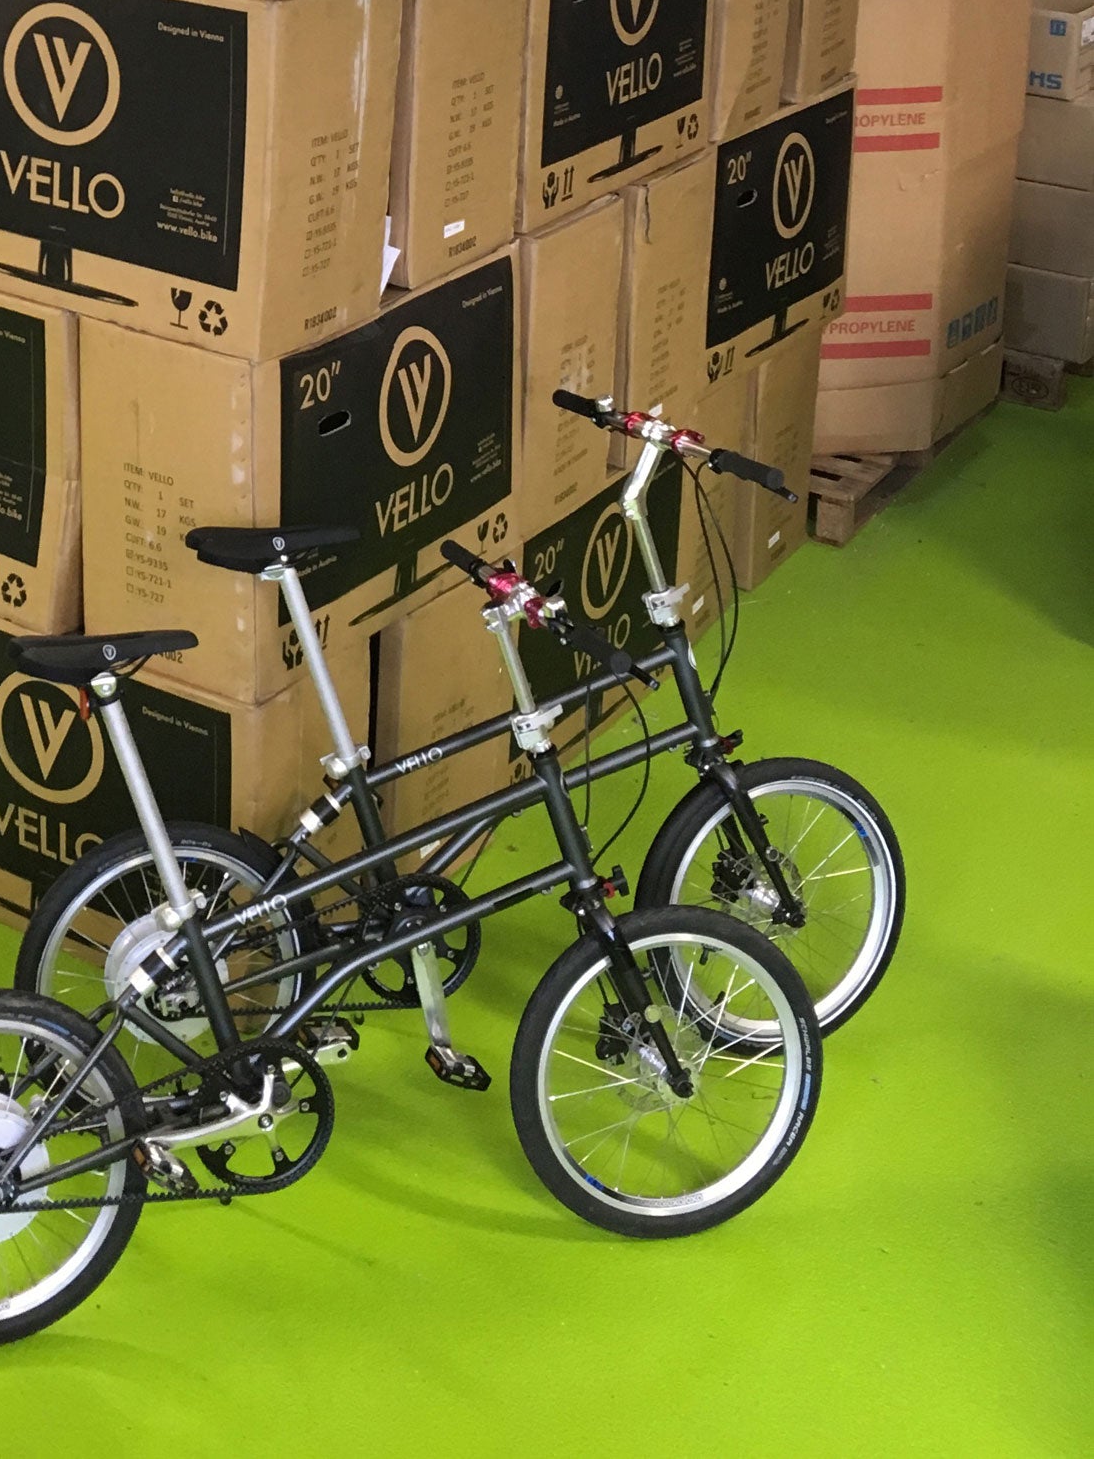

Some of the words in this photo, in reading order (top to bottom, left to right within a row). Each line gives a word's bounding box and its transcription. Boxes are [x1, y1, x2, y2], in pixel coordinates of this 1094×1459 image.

[606, 52, 662, 106] VELLO
[0, 150, 125, 219] VELLO
[727, 151, 752, 185] 20"
[766, 242, 814, 291] VELLO
[299, 360, 341, 409] 20"
[149, 472, 174, 486] VELLO
[375, 463, 454, 537] VELLO
[156, 508, 166, 518] 17
[179, 497, 194, 508] SET
[535, 538, 565, 581] 20"
